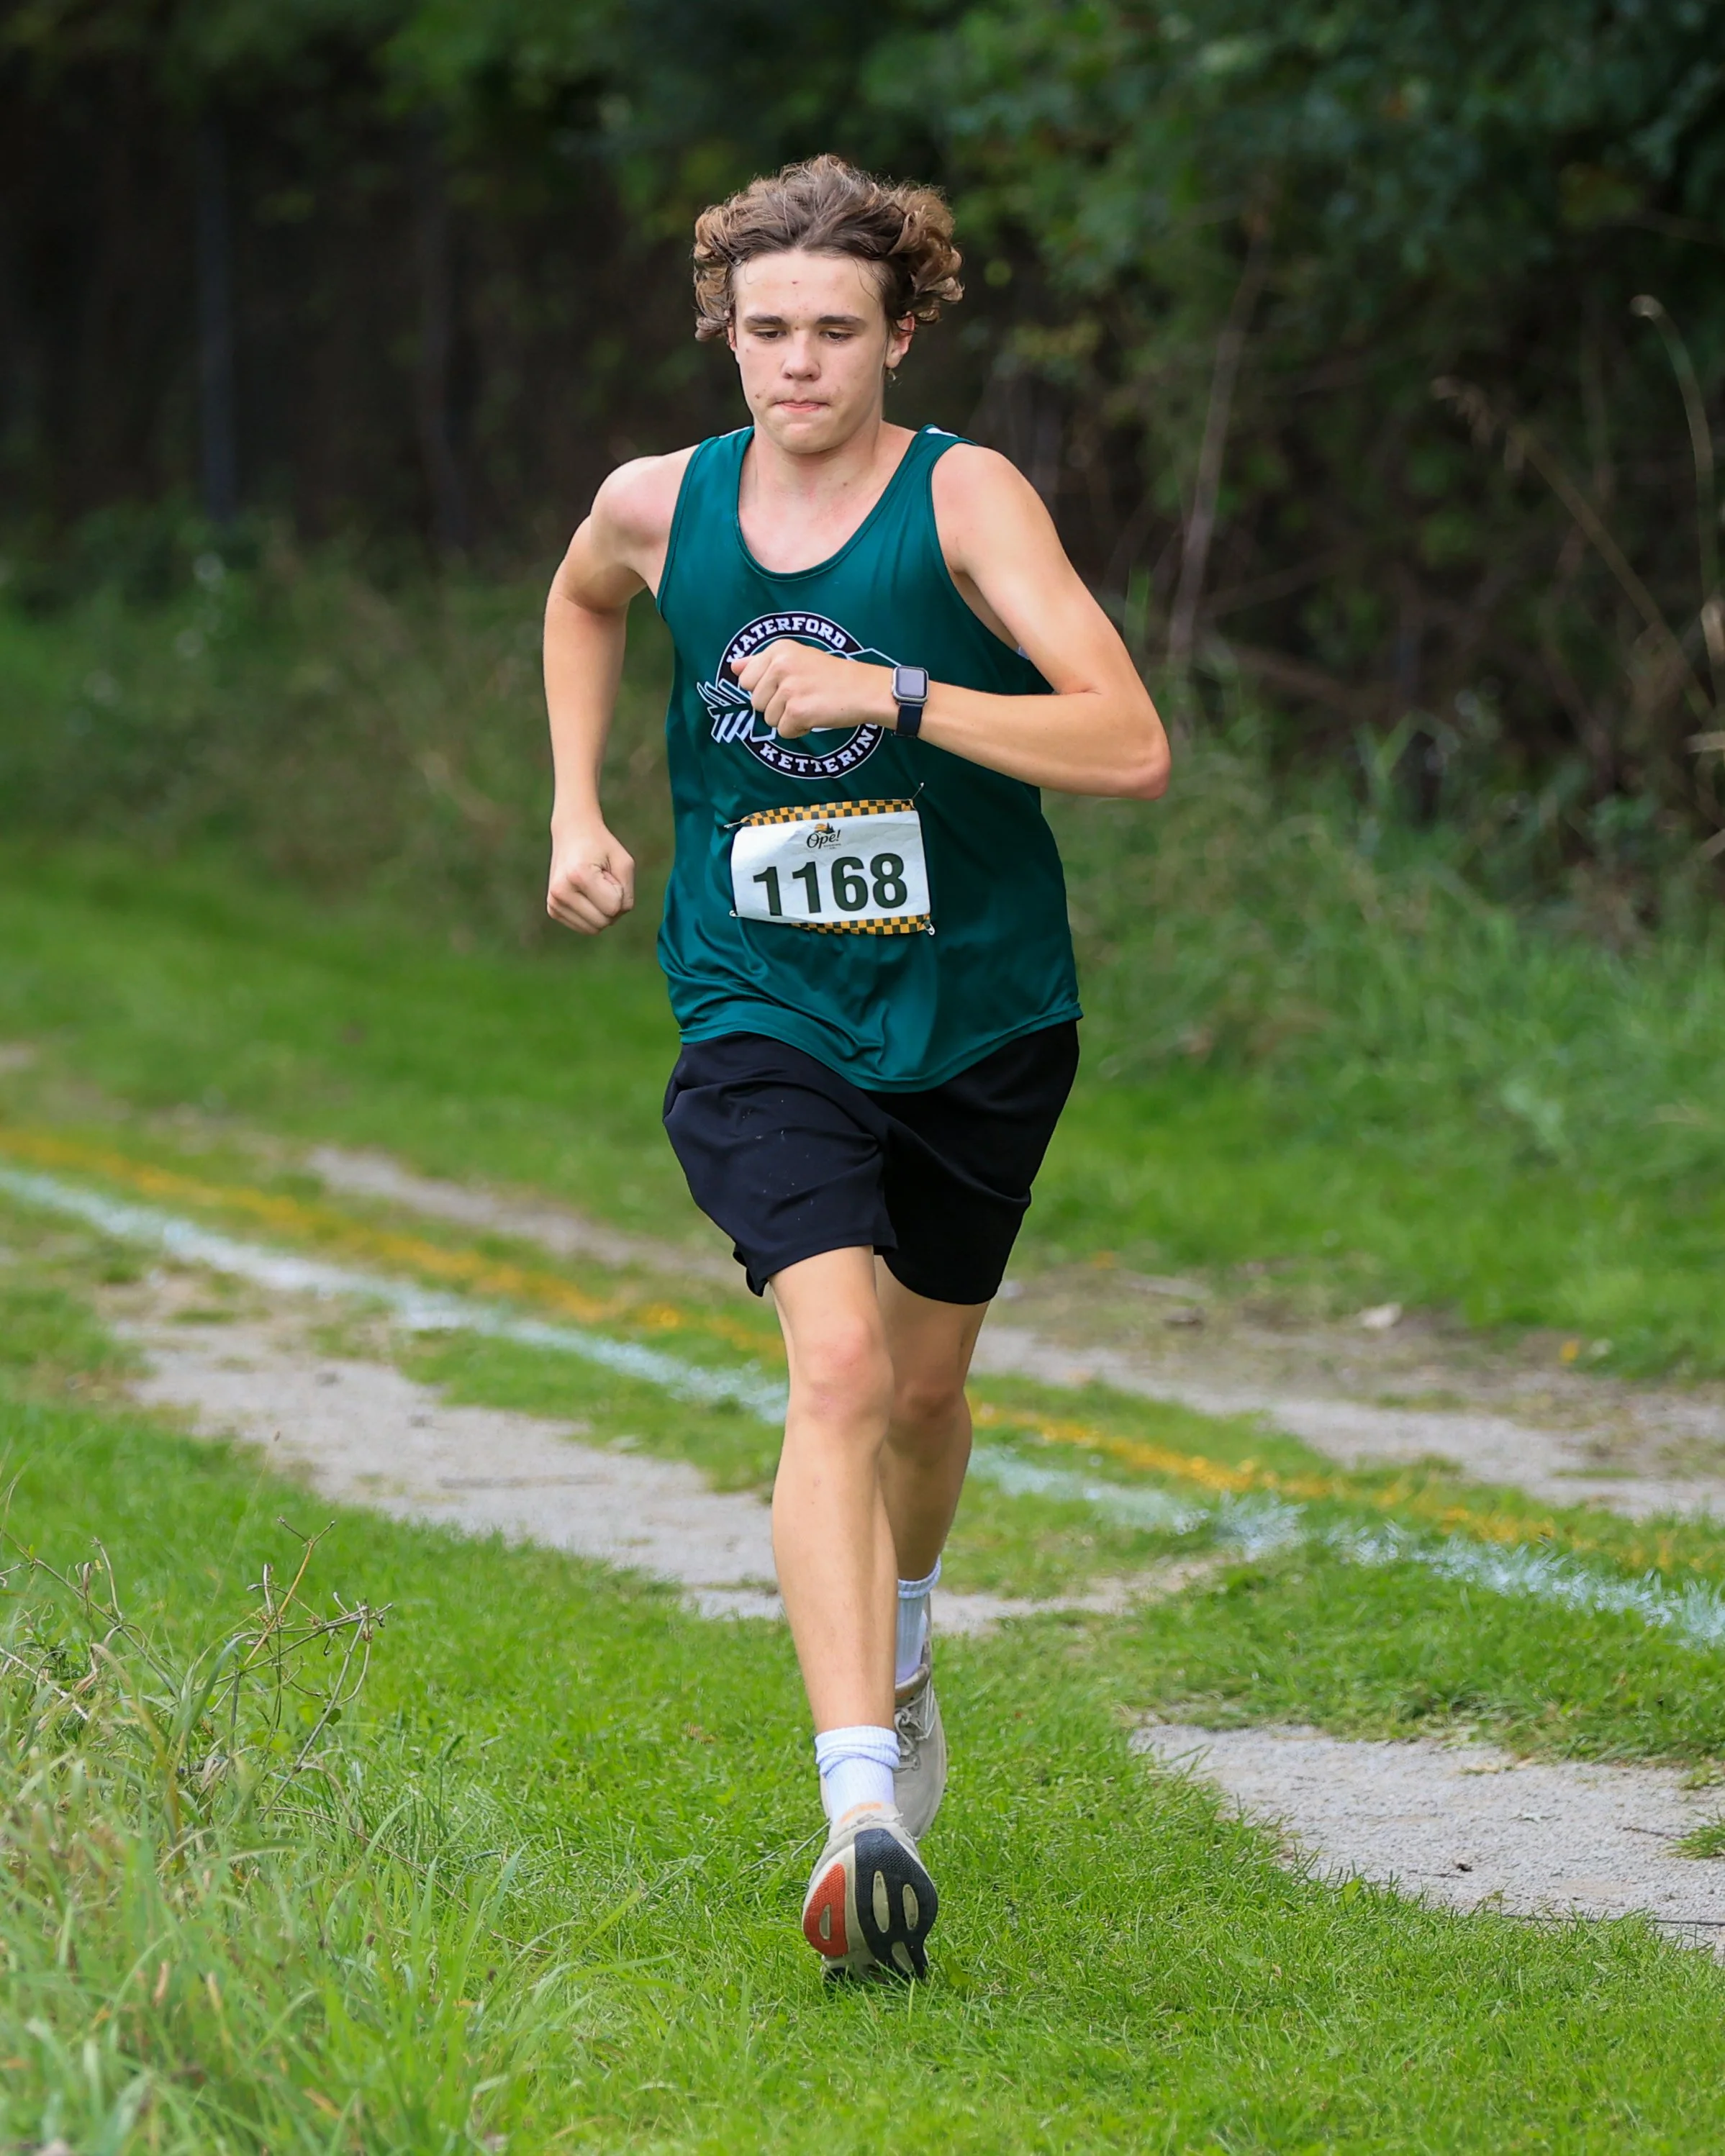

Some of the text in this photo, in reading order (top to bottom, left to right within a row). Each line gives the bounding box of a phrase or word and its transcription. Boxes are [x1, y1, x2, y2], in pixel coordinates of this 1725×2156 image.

[760, 723, 878, 773] KETTERIN
[807, 829, 841, 849] Ope!
[753, 853, 908, 916] 1168
